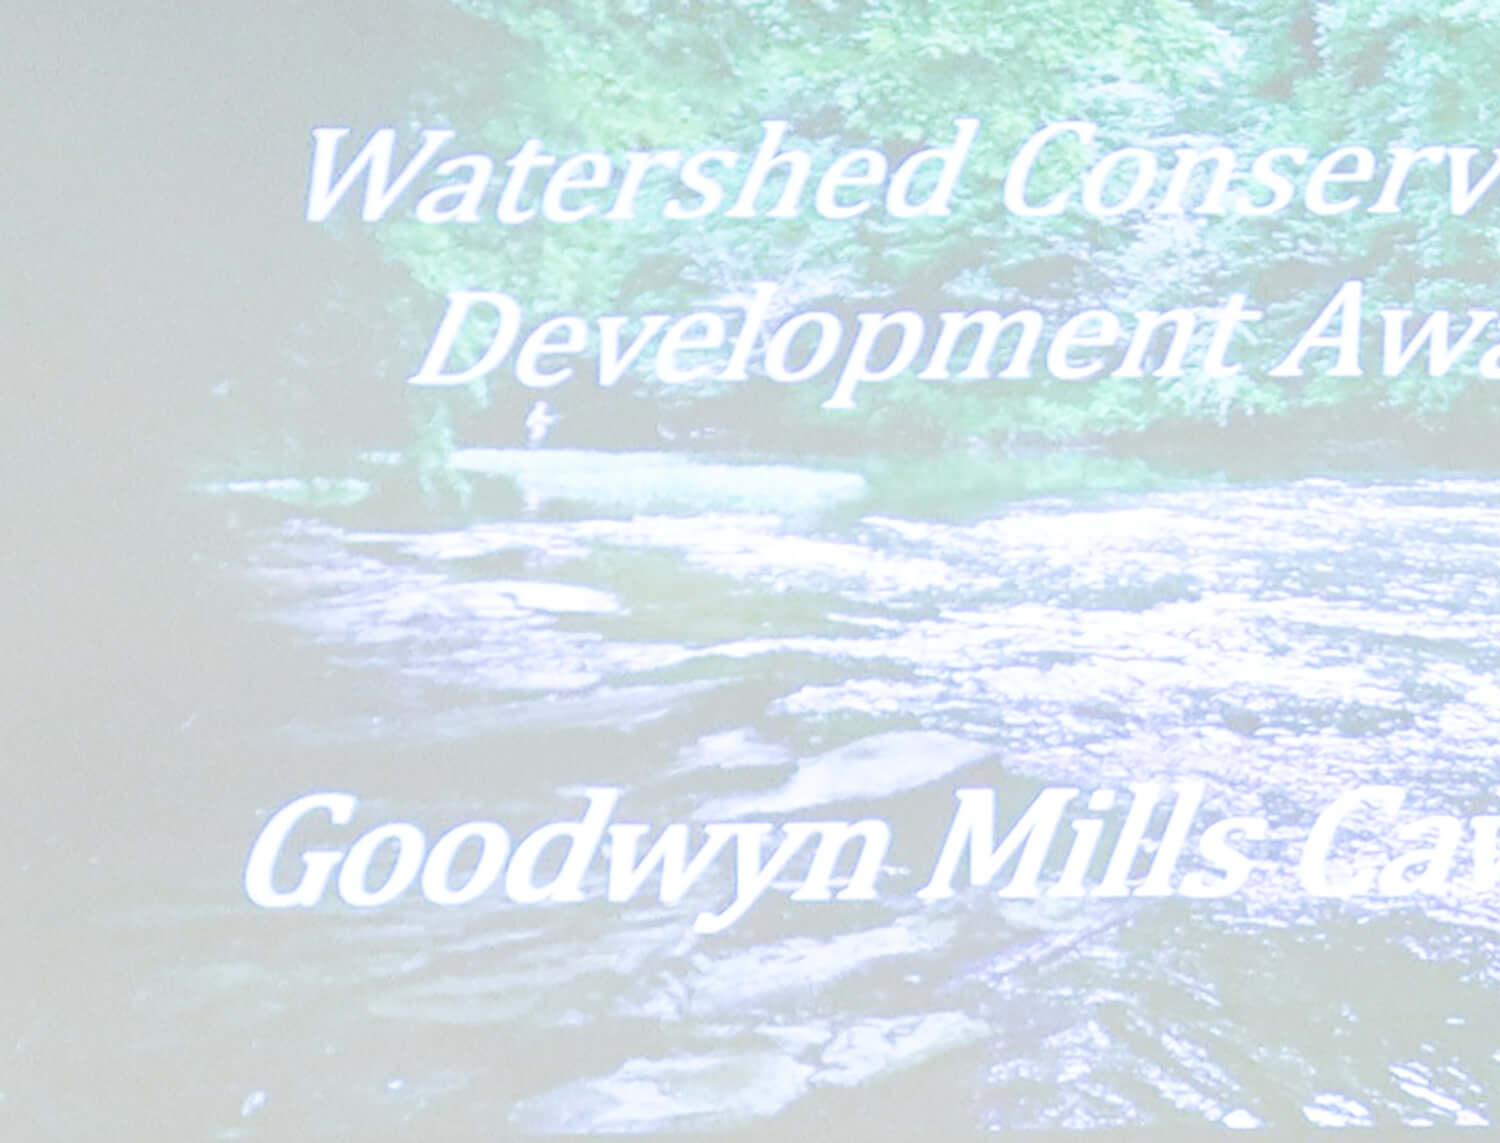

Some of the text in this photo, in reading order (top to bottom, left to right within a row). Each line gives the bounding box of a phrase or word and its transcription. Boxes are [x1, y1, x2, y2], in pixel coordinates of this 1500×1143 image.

[305, 118, 982, 224] Watershed
[408, 281, 1262, 408] Development
[243, 786, 891, 934] Goodwyn
[916, 780, 1268, 902] Mills
